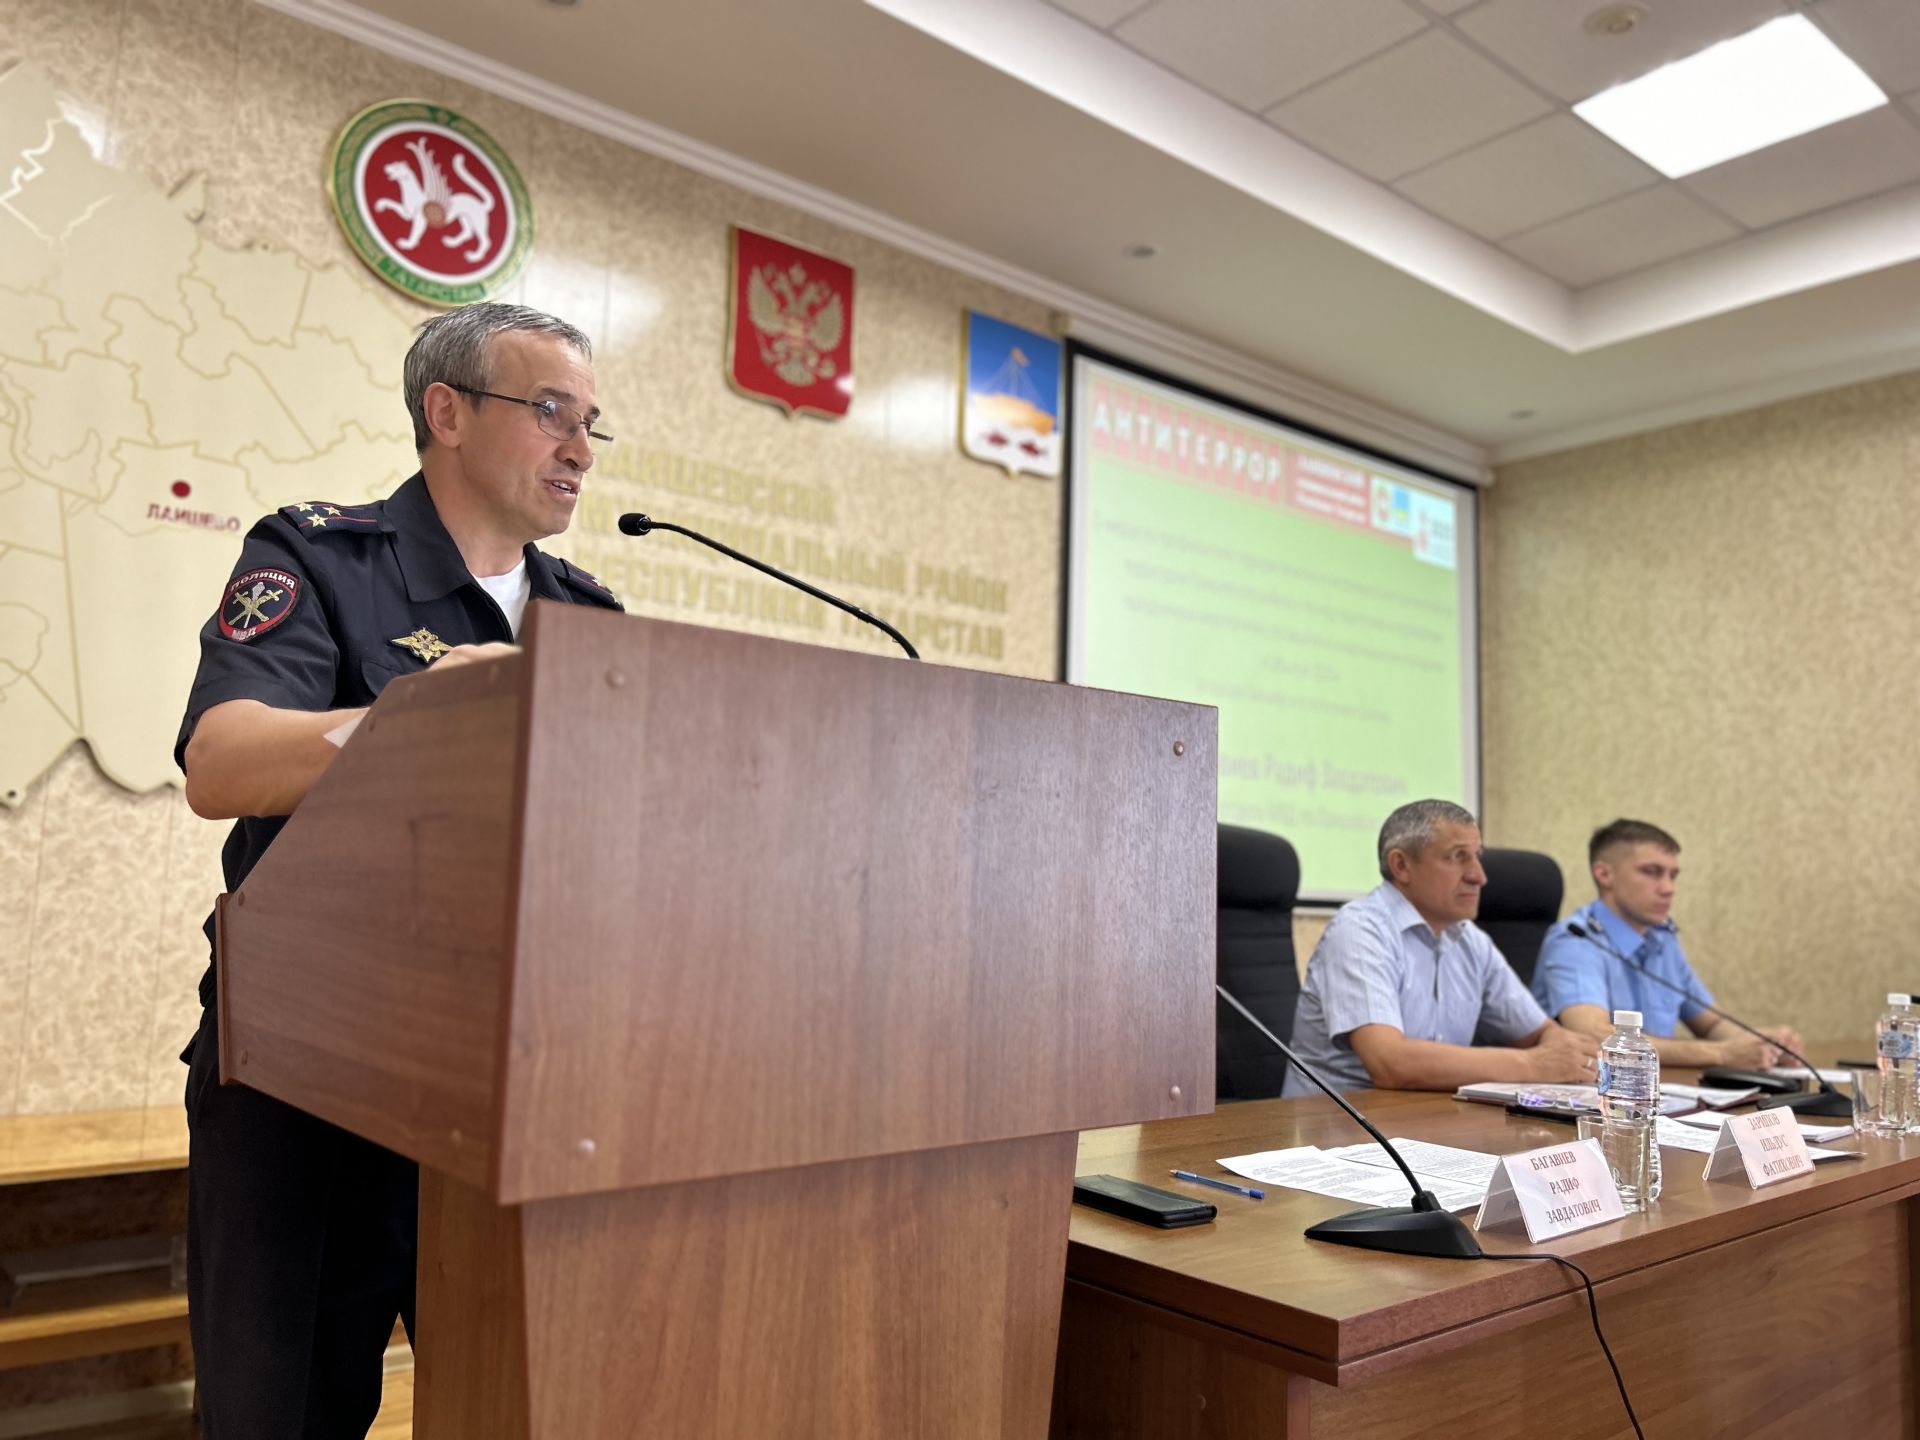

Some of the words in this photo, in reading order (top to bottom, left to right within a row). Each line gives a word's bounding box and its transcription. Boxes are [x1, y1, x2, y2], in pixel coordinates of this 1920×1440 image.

[1093, 402, 1281, 485] АНТИТЕРРОР
[231, 572, 296, 592] ПОЛИЦИЯ
[917, 561, 1007, 613] РАЙОН
[231, 626, 257, 641] МВД
[1529, 1150, 1577, 1171] БАГАВИЕВ
[1549, 1177, 1580, 1196] РАДИФ
[1545, 1198, 1602, 1224] ЗАВДАТОВИЧ
